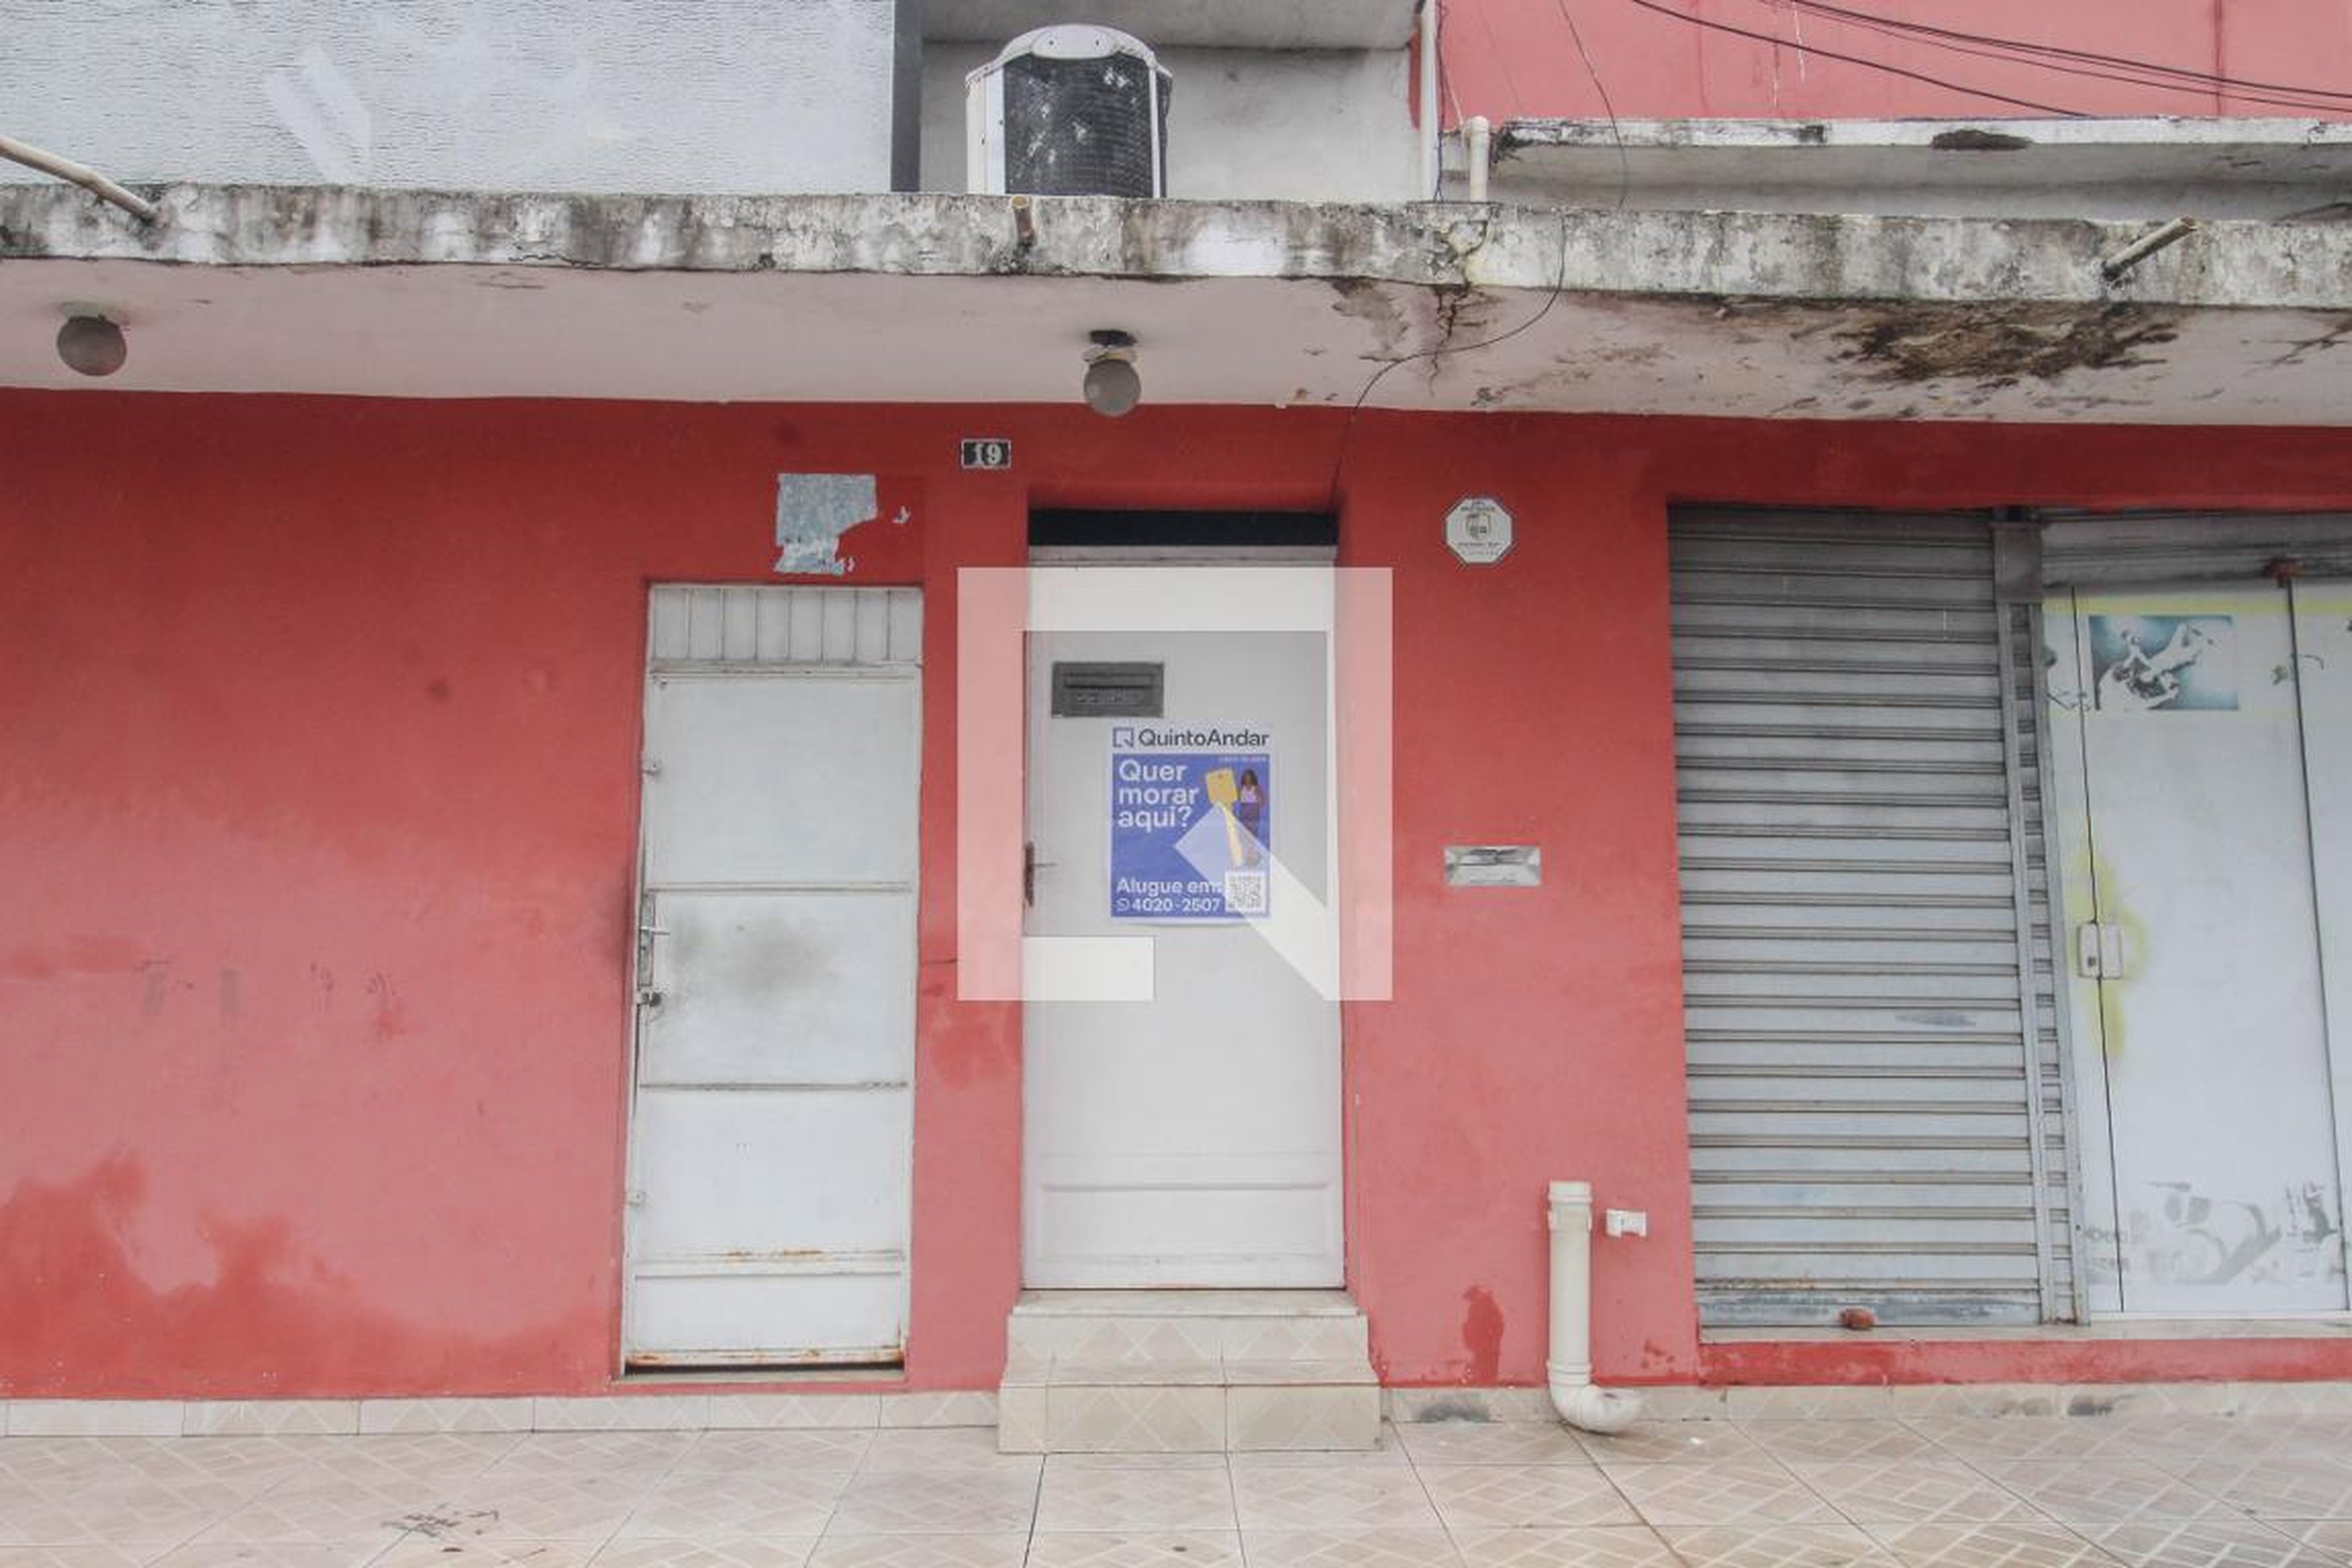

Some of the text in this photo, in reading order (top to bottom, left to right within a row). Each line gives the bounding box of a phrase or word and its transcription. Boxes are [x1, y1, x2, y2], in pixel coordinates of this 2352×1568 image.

[971, 443, 1003, 465] 19
[1139, 728, 1269, 747] QuintoAndar
[1118, 759, 1188, 782] Quer
[1118, 787, 1200, 805] morar
[1118, 805, 1193, 834] aqui?
[1117, 878, 1183, 897] Alugue
